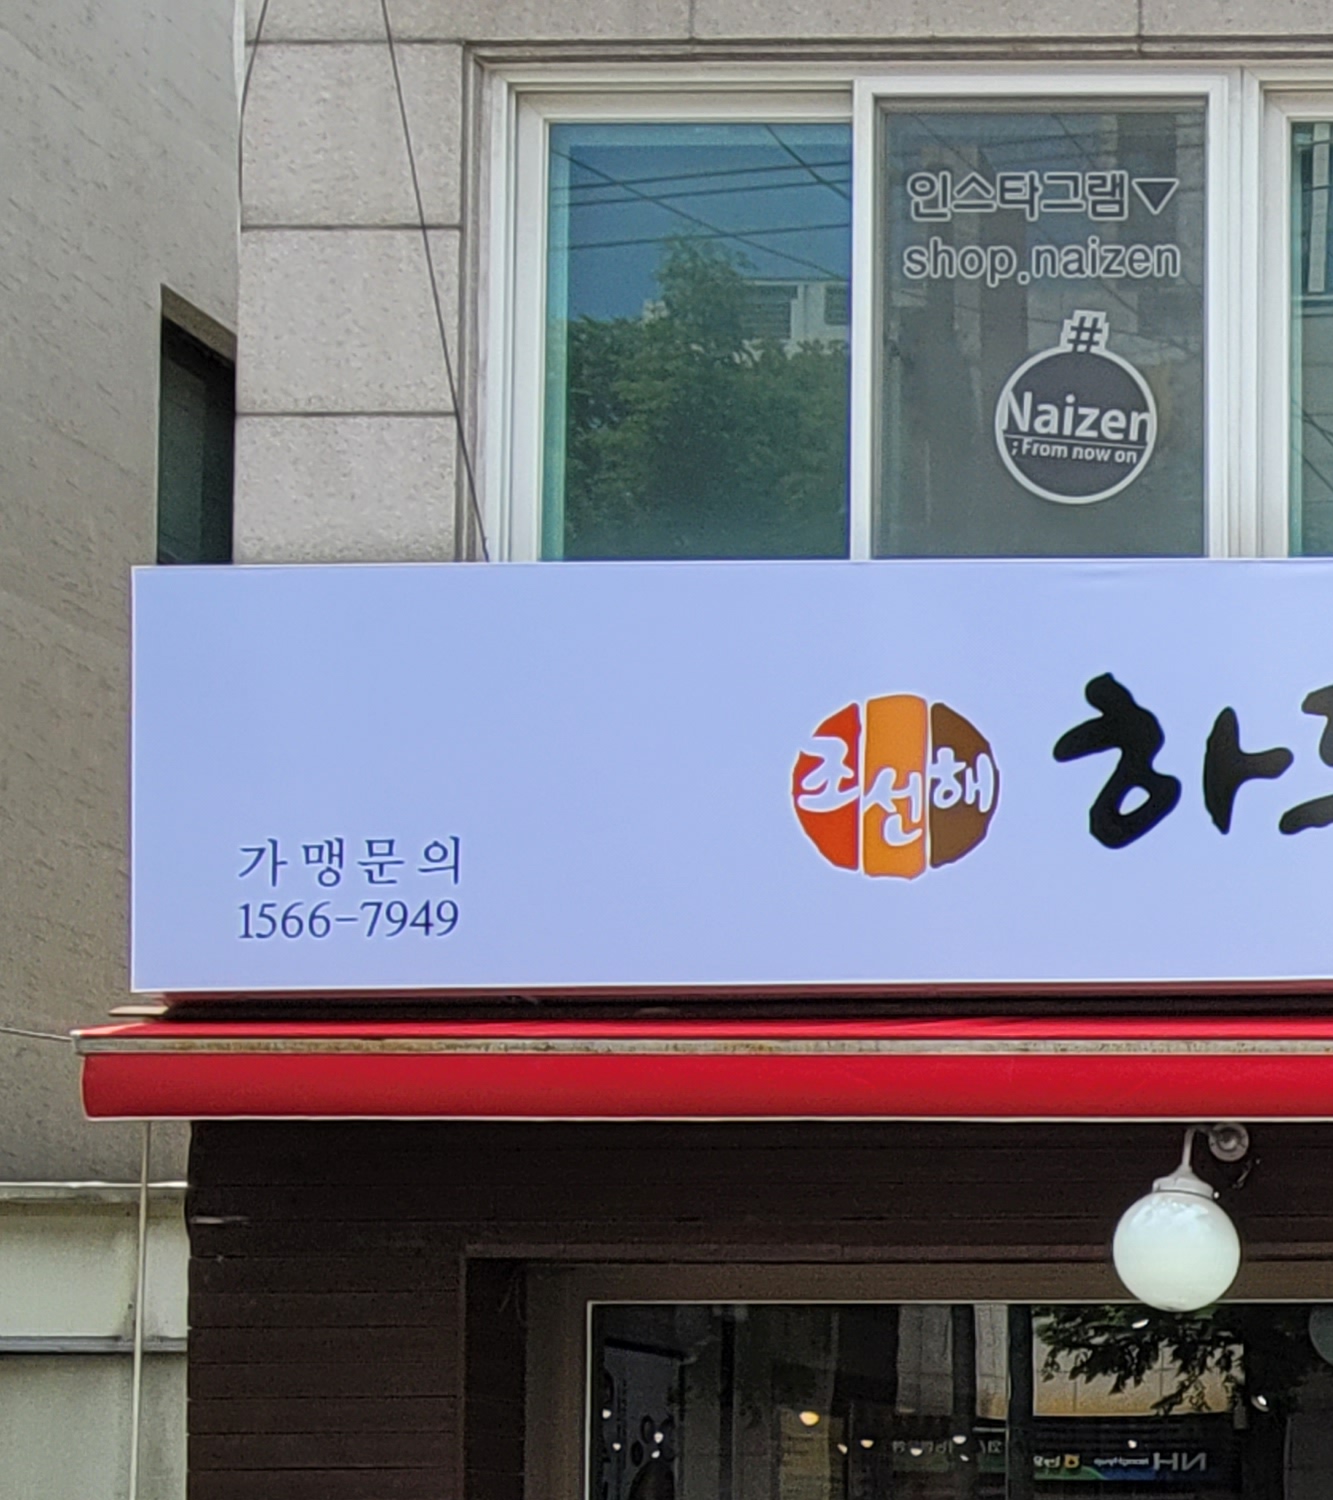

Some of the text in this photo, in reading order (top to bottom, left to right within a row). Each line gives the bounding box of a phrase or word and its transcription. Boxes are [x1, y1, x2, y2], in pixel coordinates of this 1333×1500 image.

[906, 171, 1129, 221] 인스타그램
[902, 237, 1180, 286] shop.naizen
[999, 391, 1151, 442] Naizen
[1071, 446, 1112, 462] now
[1114, 450, 1138, 464] on
[795, 735, 996, 847] 조선해
[238, 835, 463, 888] 가맹문의
[238, 899, 460, 940] 1566-7949
